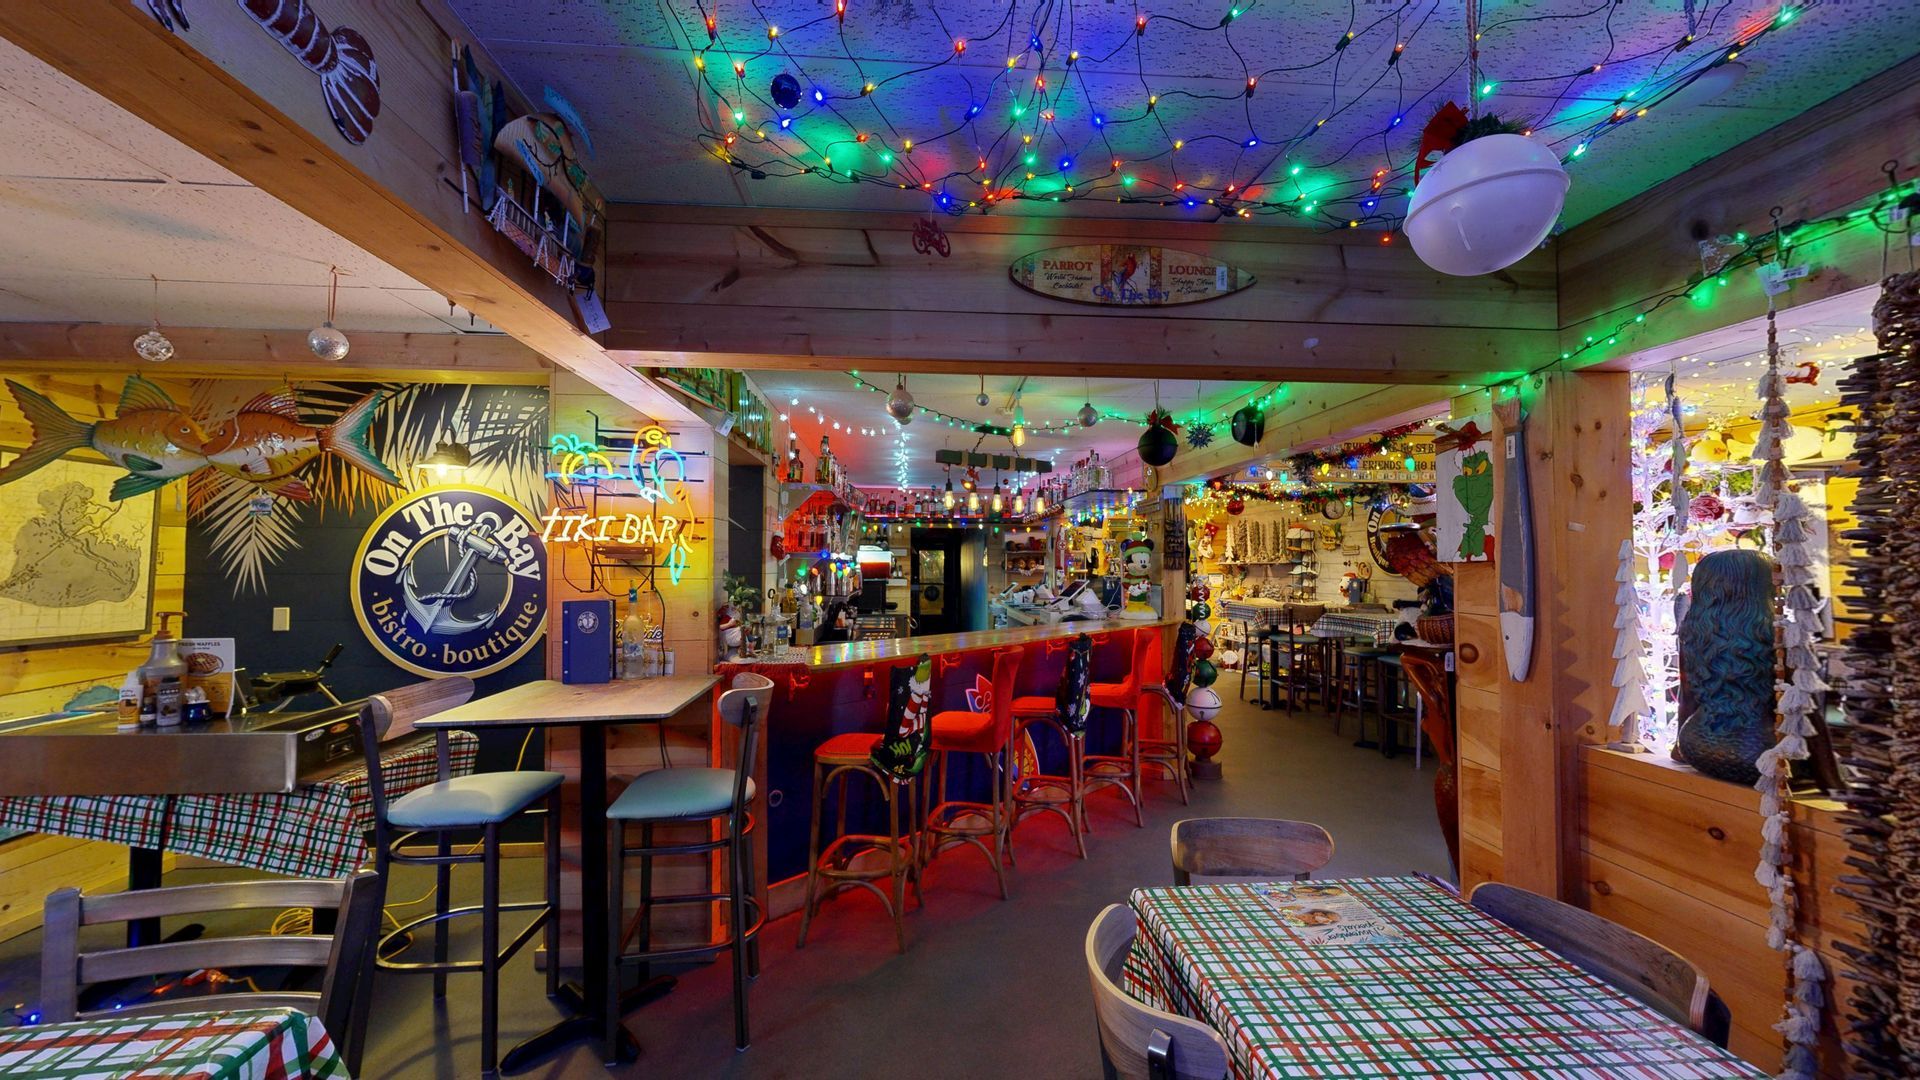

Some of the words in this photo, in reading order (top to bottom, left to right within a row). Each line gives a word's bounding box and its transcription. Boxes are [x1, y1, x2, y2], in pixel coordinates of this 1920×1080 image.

[1043, 260, 1093, 273] PARROT
[1044, 272, 1066, 281] World
[1067, 274, 1093, 282] Famous
[1362, 460, 1402, 470] FRIENDS
[541, 508, 617, 544] TIKI
[618, 514, 678, 545] BAR
[1367, 510, 1381, 534] On
[364, 529, 414, 577] On
[401, 496, 474, 536] The
[494, 514, 542, 582] Bay
[371, 598, 428, 658] bistro
[442, 601, 539, 665] boutique
